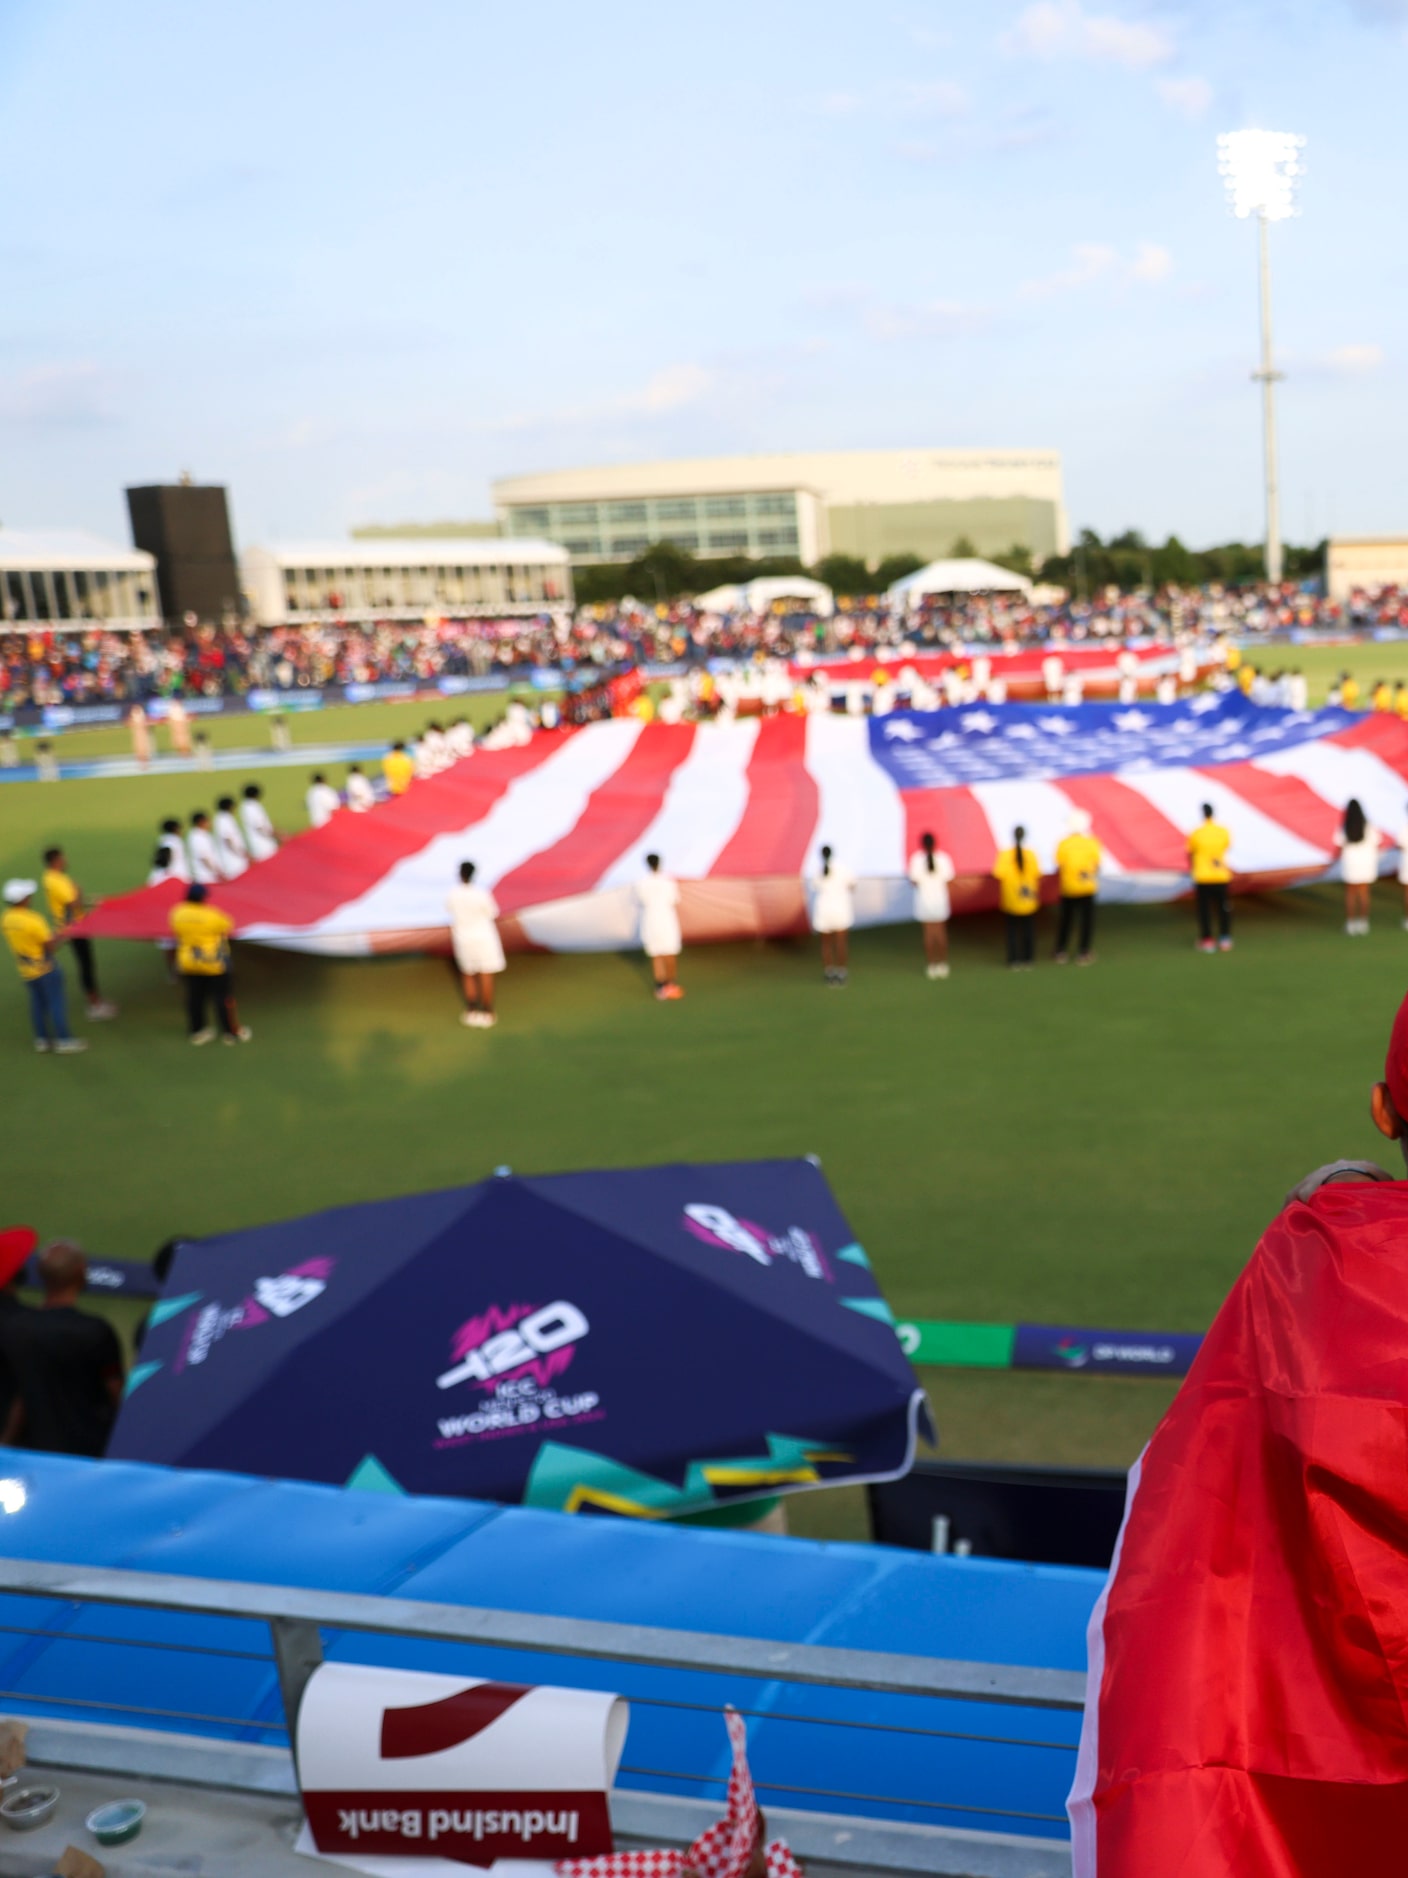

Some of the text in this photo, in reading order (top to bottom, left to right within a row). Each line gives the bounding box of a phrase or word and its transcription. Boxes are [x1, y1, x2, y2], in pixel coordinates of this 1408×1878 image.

[437, 1401, 541, 1438] WORLD
[543, 1391, 600, 1418] CUP
[337, 1809, 580, 1842] IndusInd Bank
